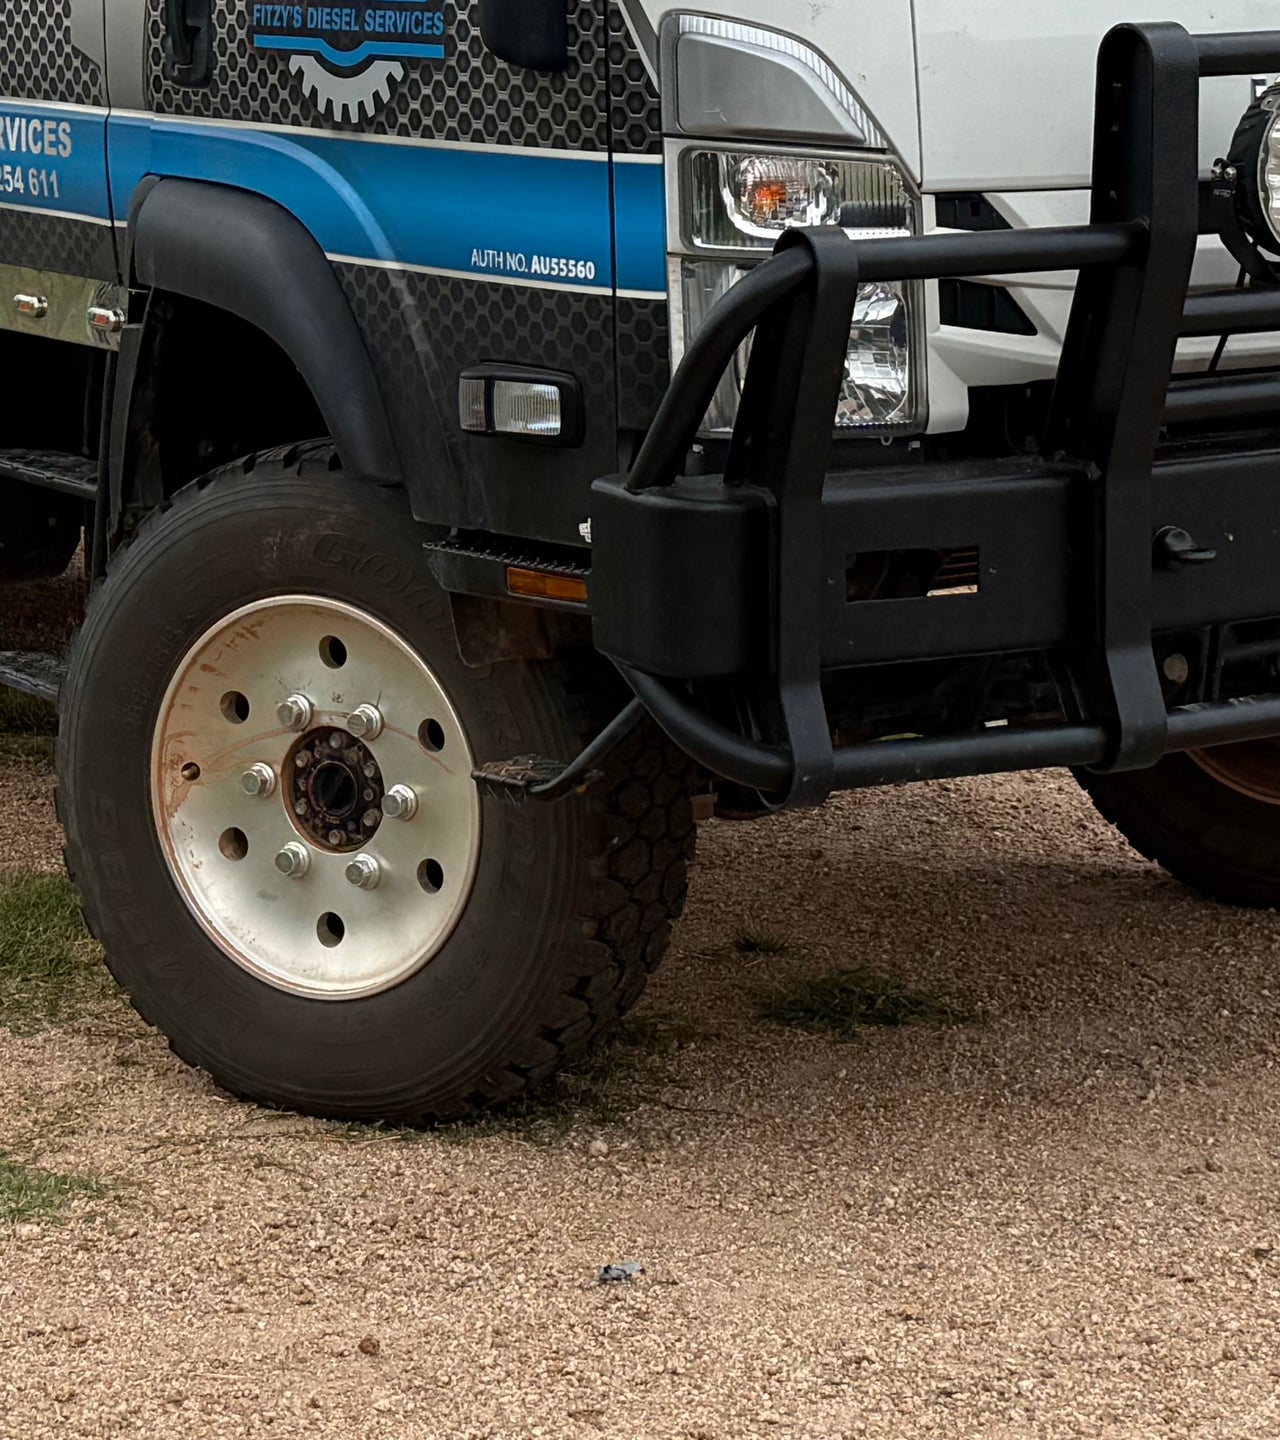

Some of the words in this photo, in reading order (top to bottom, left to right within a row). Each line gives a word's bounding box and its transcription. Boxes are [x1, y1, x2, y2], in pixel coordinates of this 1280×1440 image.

[253, 4, 302, 29] FITZY'S
[307, 6, 360, 32] DIESEL
[364, 9, 445, 36] SERVICES
[28, 167, 60, 199] 611
[471, 248, 504, 270] AUTH
[506, 251, 529, 273] NO.
[531, 255, 595, 280] AU55560
